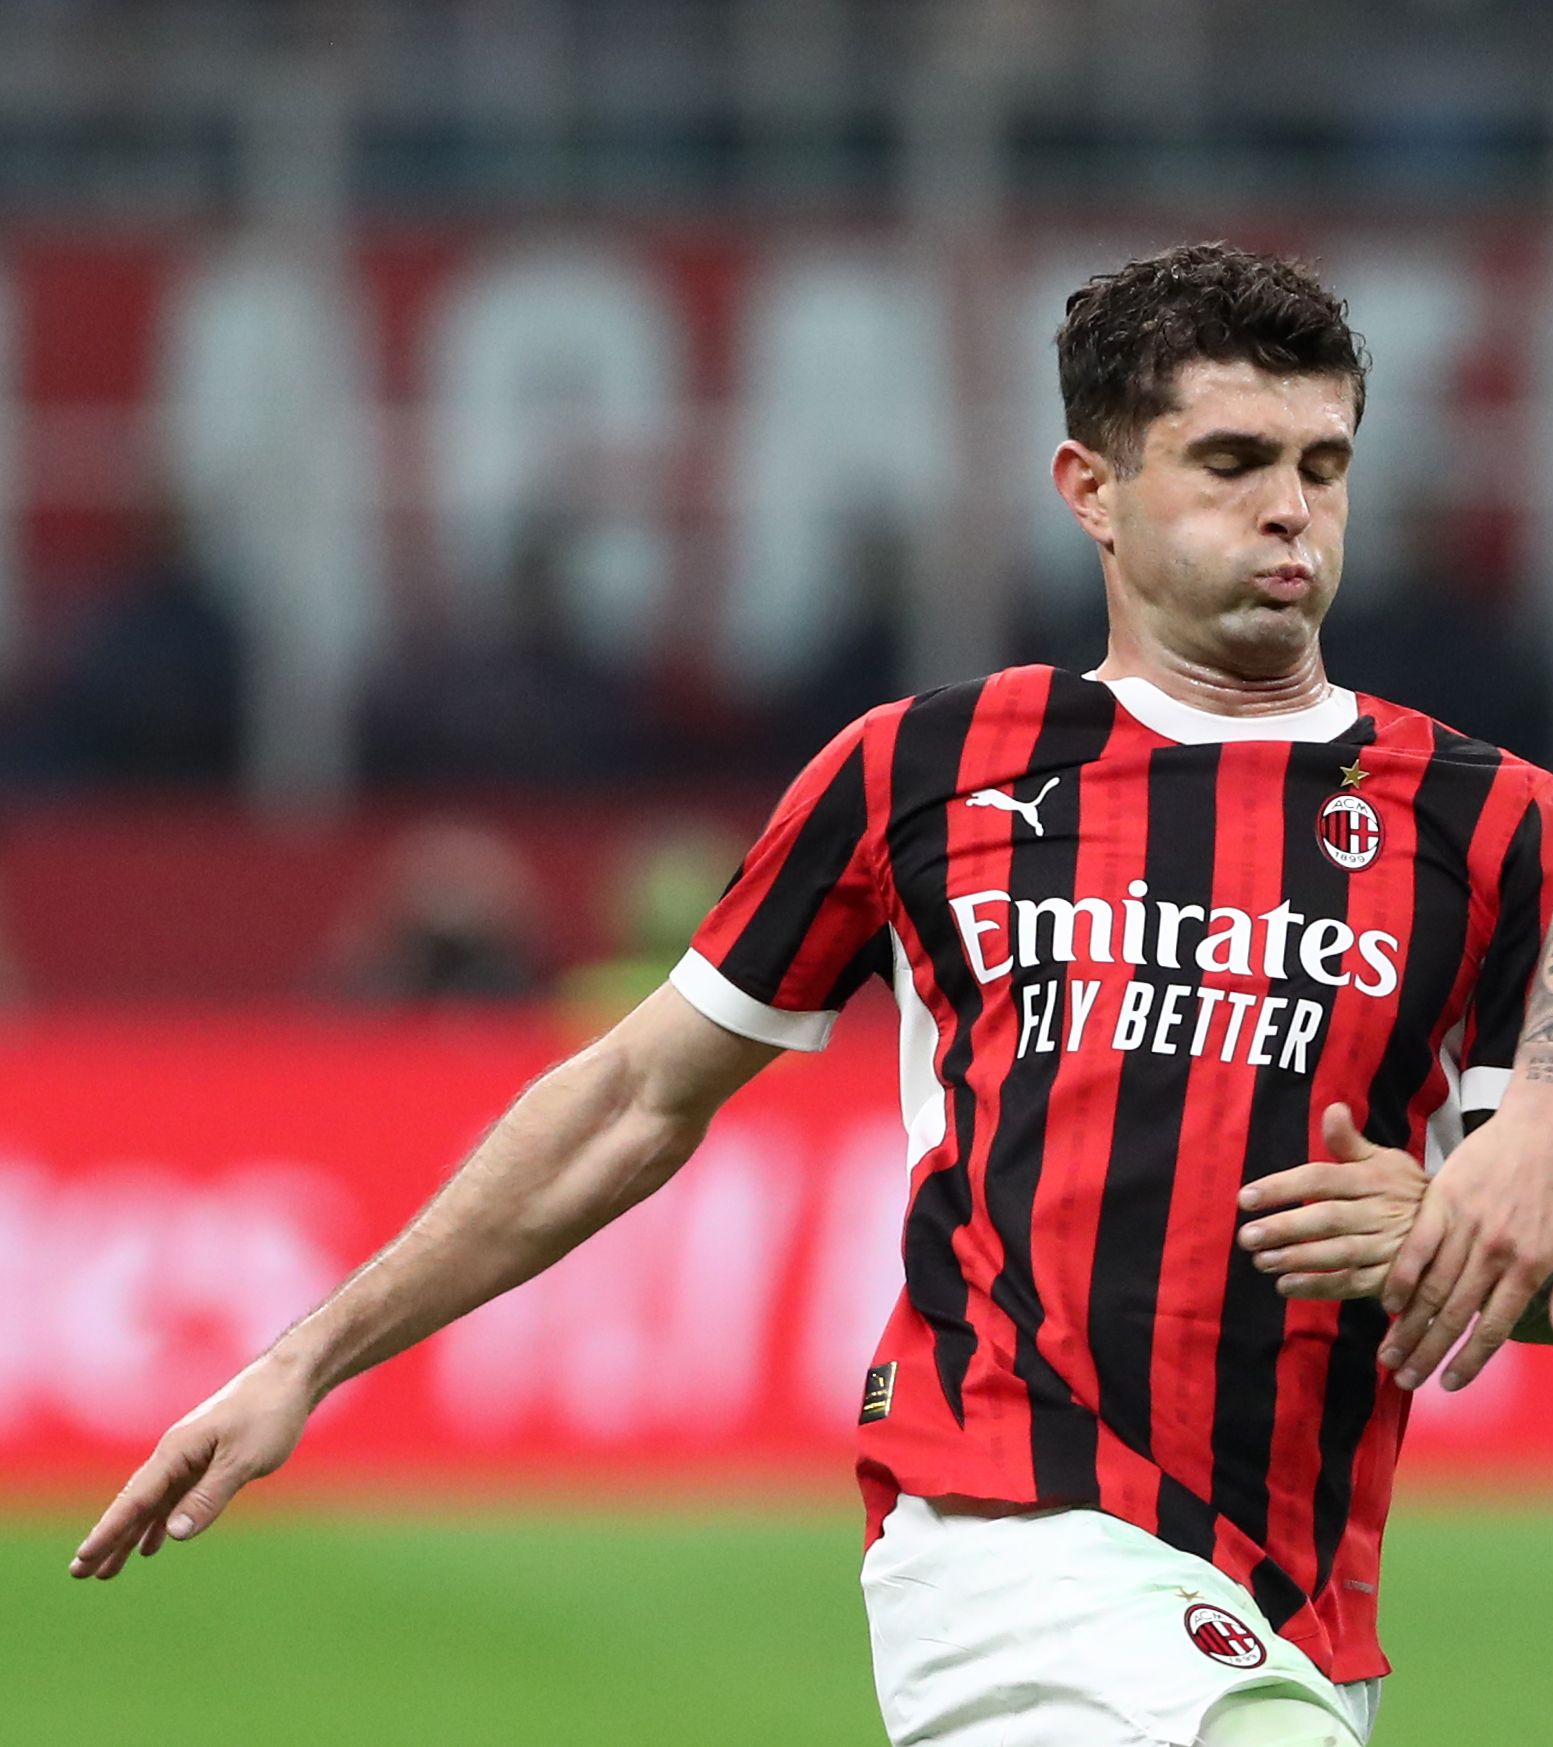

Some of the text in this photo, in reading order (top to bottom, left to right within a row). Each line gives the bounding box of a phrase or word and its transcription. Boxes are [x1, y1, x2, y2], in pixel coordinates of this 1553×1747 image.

[1332, 799, 1367, 814] ACM
[1335, 852, 1365, 863] 1899
[948, 879, 1400, 998] Emirates
[1016, 979, 1325, 1075] FLY BETTER
